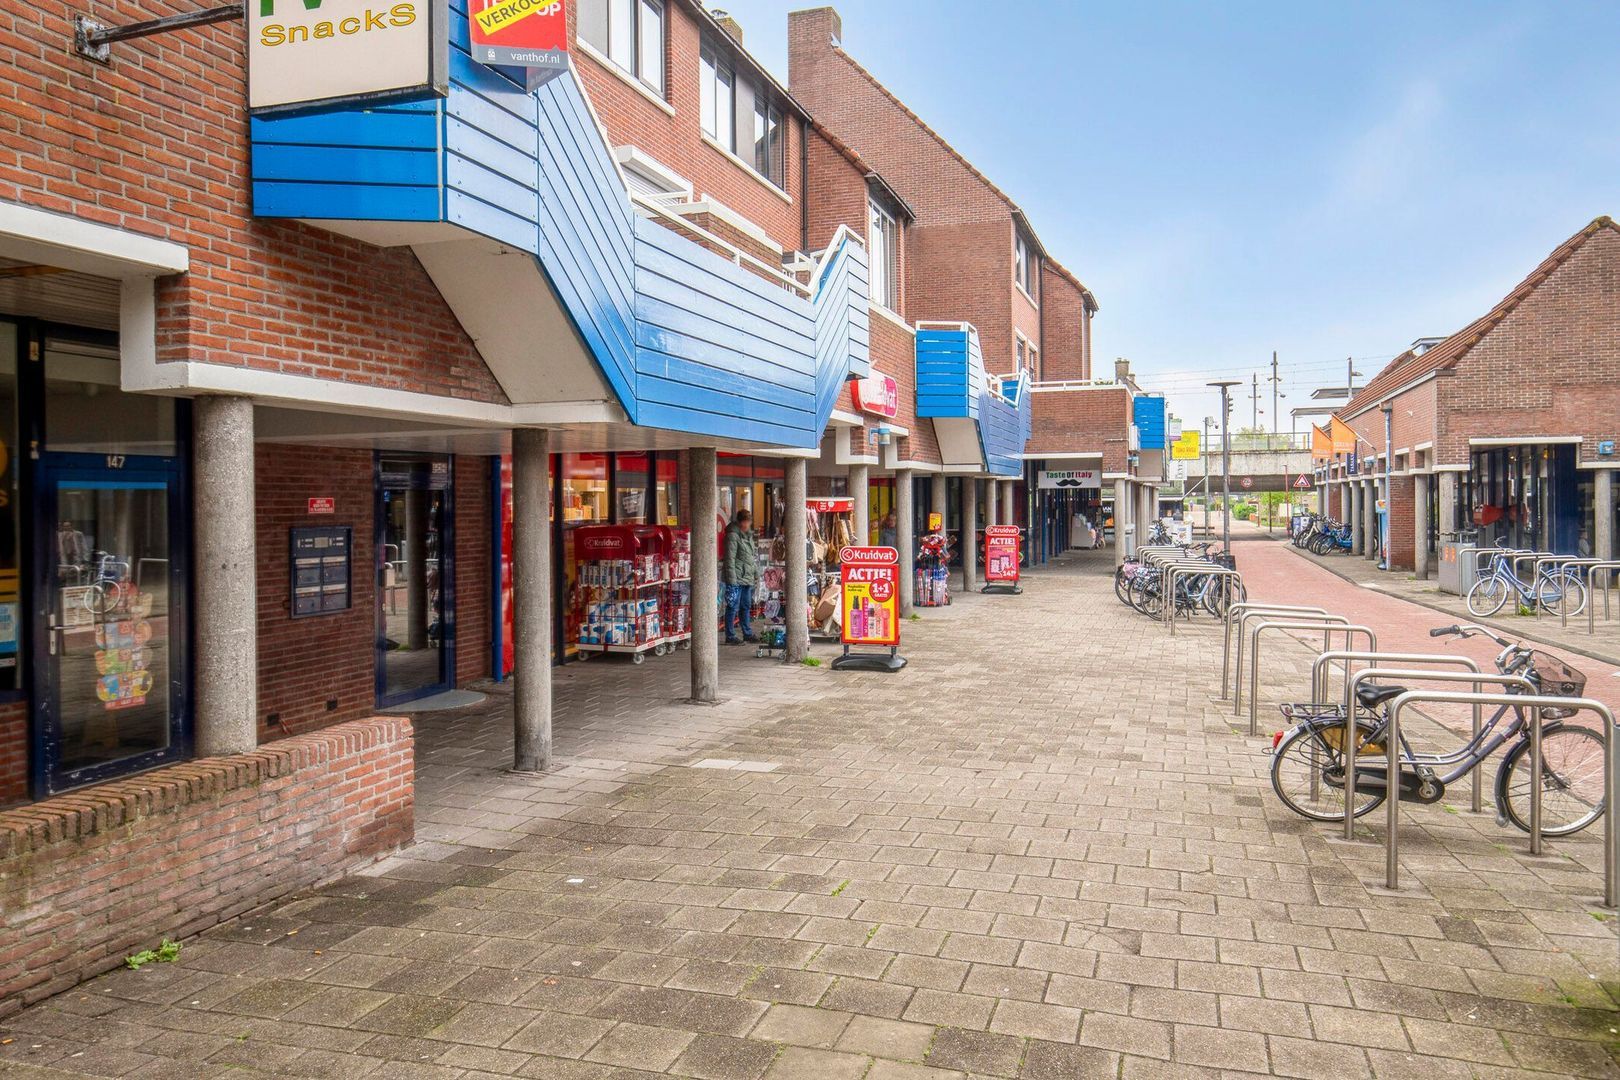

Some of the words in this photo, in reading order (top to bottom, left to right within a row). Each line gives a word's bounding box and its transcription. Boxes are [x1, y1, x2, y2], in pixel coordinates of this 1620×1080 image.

[510, 51, 560, 64] vanthof.nl
[106, 455, 126, 469] 147
[1046, 471, 1066, 479] Taste
[1075, 471, 1093, 479] Italy
[594, 538, 620, 547] Kruidvat
[990, 537, 1016, 545] ACTIE!
[854, 550, 893, 560] Kruidvat
[848, 568, 892, 581] ACTIE!
[872, 582, 890, 593] 1+1
